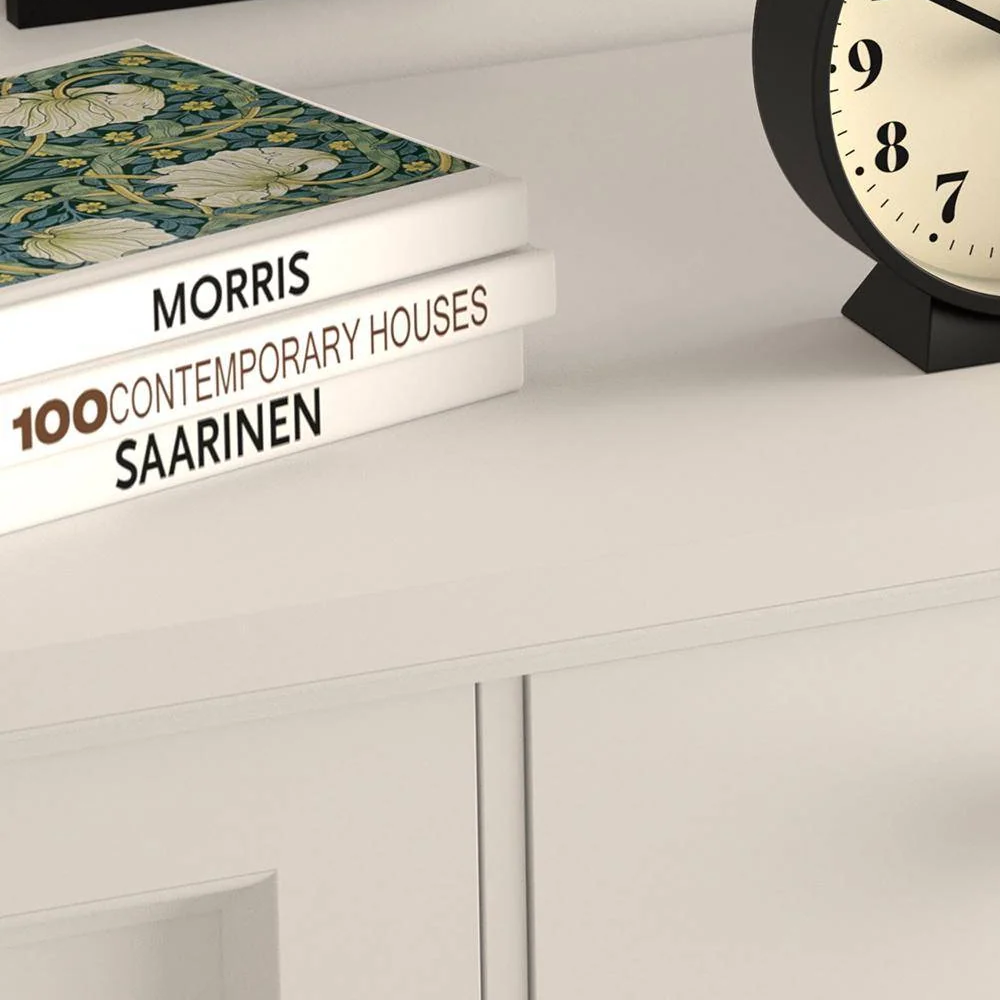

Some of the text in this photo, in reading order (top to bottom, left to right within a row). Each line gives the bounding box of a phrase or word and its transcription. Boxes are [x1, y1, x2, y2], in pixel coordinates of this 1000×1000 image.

[848, 38, 883, 92] 9
[874, 120, 910, 173] 8
[934, 170, 970, 224] 7
[152, 250, 310, 331] MORRIS
[370, 284, 488, 355] HOUSES
[115, 387, 322, 490] SAARINEN
